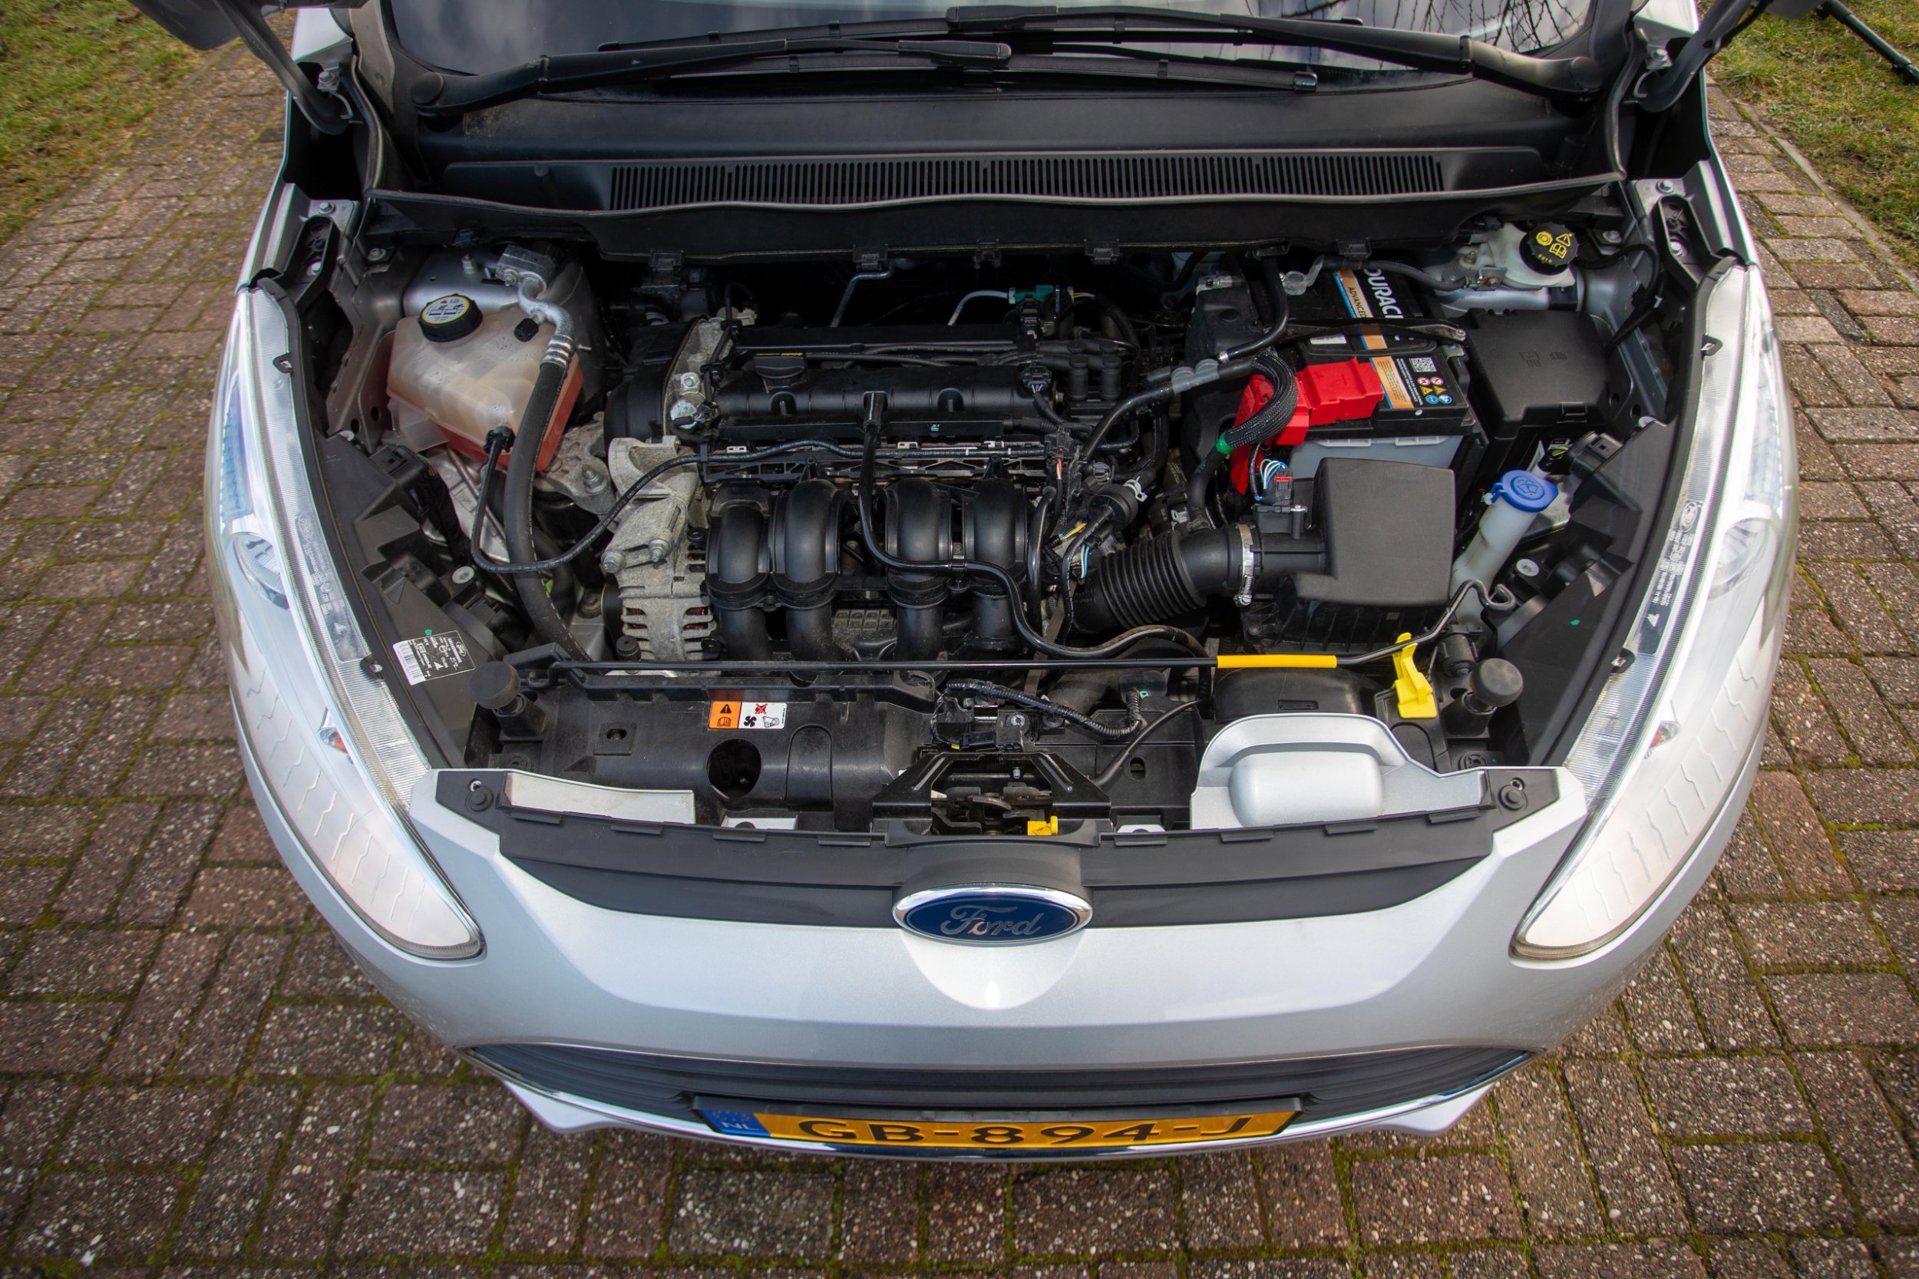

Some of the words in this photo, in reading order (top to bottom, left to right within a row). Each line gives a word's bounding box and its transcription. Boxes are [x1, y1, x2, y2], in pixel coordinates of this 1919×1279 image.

[939, 904, 1045, 936] Ford
[721, 1120, 761, 1132] NL
[798, 1116, 1252, 1144] GB-894-J
